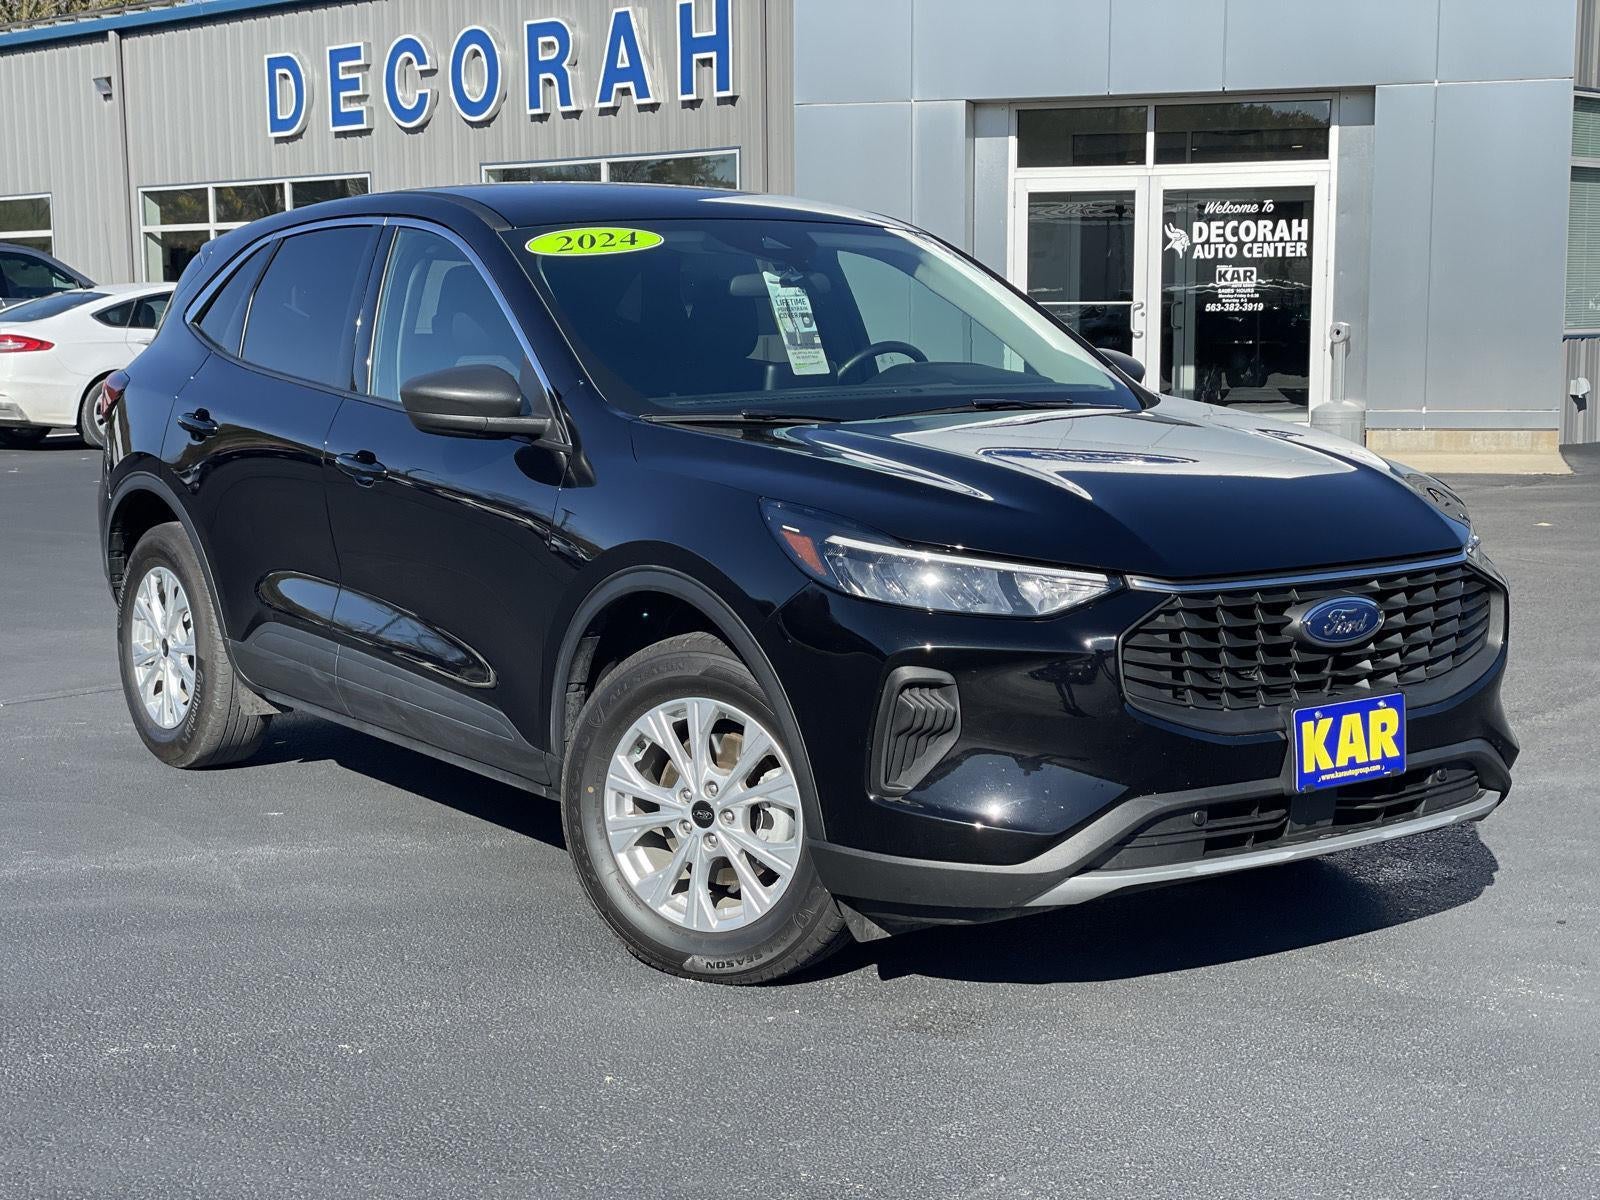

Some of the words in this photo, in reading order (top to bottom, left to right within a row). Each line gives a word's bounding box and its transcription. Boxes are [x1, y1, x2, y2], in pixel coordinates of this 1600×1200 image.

[264, 0, 733, 138] DECORAH
[1204, 201, 1259, 214] Welcome
[1261, 199, 1275, 213] To
[1192, 219, 1309, 243] DECORAH
[556, 231, 639, 252] 2024
[1192, 244, 1238, 259] AUTO
[1242, 242, 1308, 258] CENTER
[1217, 269, 1255, 283] KAR
[775, 297, 807, 307] LIFETIME
[1205, 302, 1264, 312] 563-382-3919
[1323, 608, 1369, 636] Ford
[1302, 707, 1400, 774] KAR
